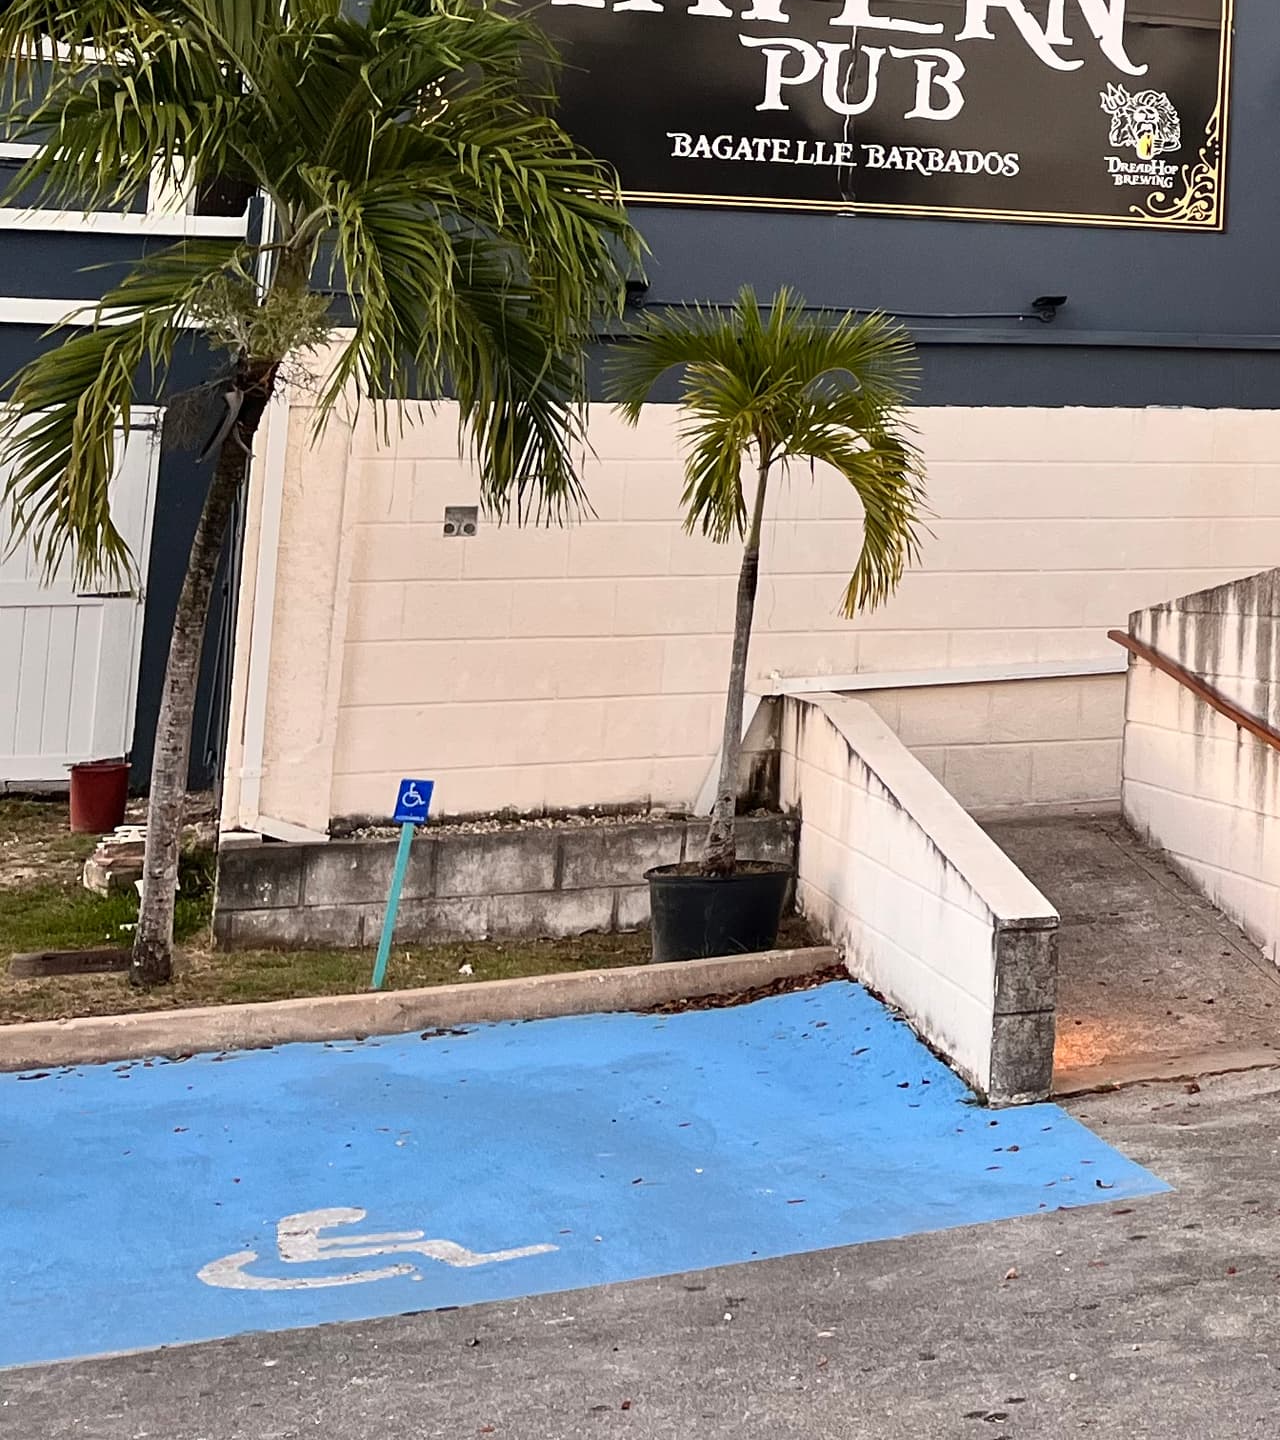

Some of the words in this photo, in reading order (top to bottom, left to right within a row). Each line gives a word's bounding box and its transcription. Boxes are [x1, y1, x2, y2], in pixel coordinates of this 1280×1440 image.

[739, 34, 966, 121] PUB
[667, 131, 856, 168] BAGATELLE
[861, 143, 1020, 178] BARBADOS
[1112, 174, 1173, 189] BREWING
